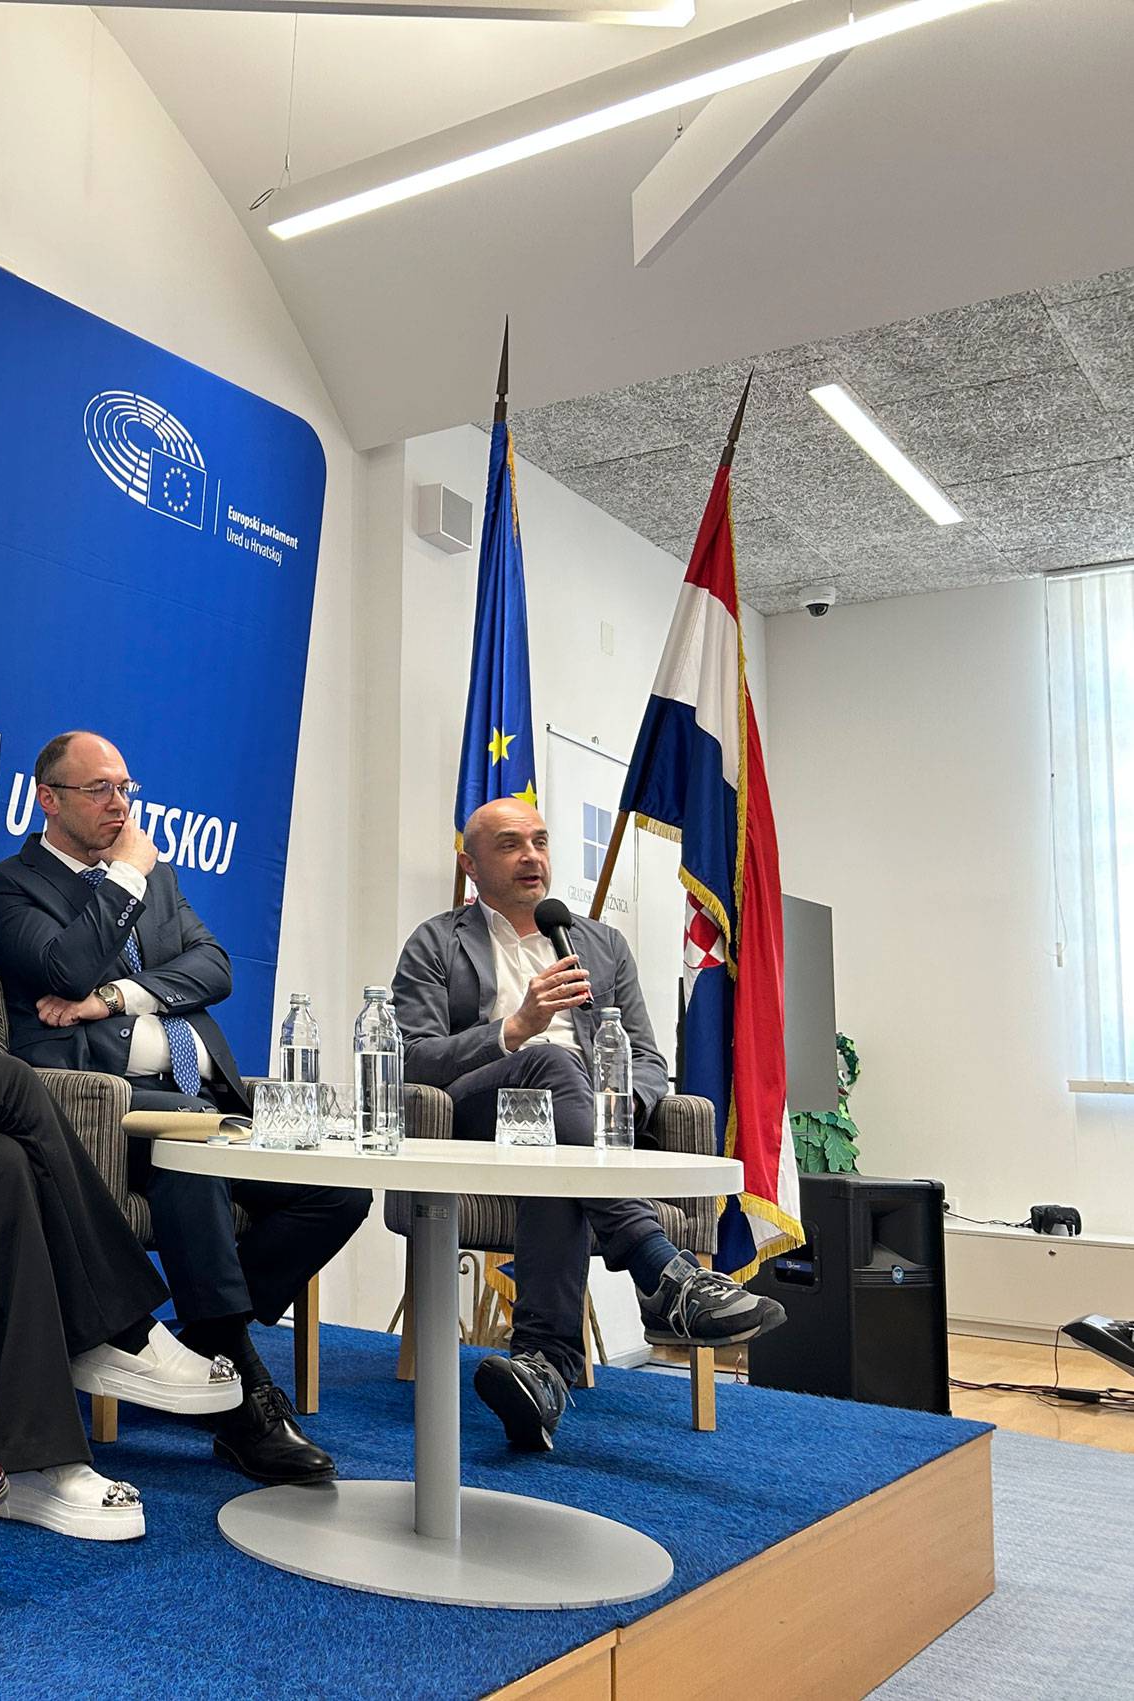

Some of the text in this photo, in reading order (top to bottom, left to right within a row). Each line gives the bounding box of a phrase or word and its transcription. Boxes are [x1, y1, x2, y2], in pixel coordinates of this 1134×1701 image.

[226, 526, 283, 567] Ured u Hrvatskoj
[228, 505, 298, 550] Europski parlament
[6, 772, 36, 836] U
[128, 799, 238, 875] ATSKOJ
